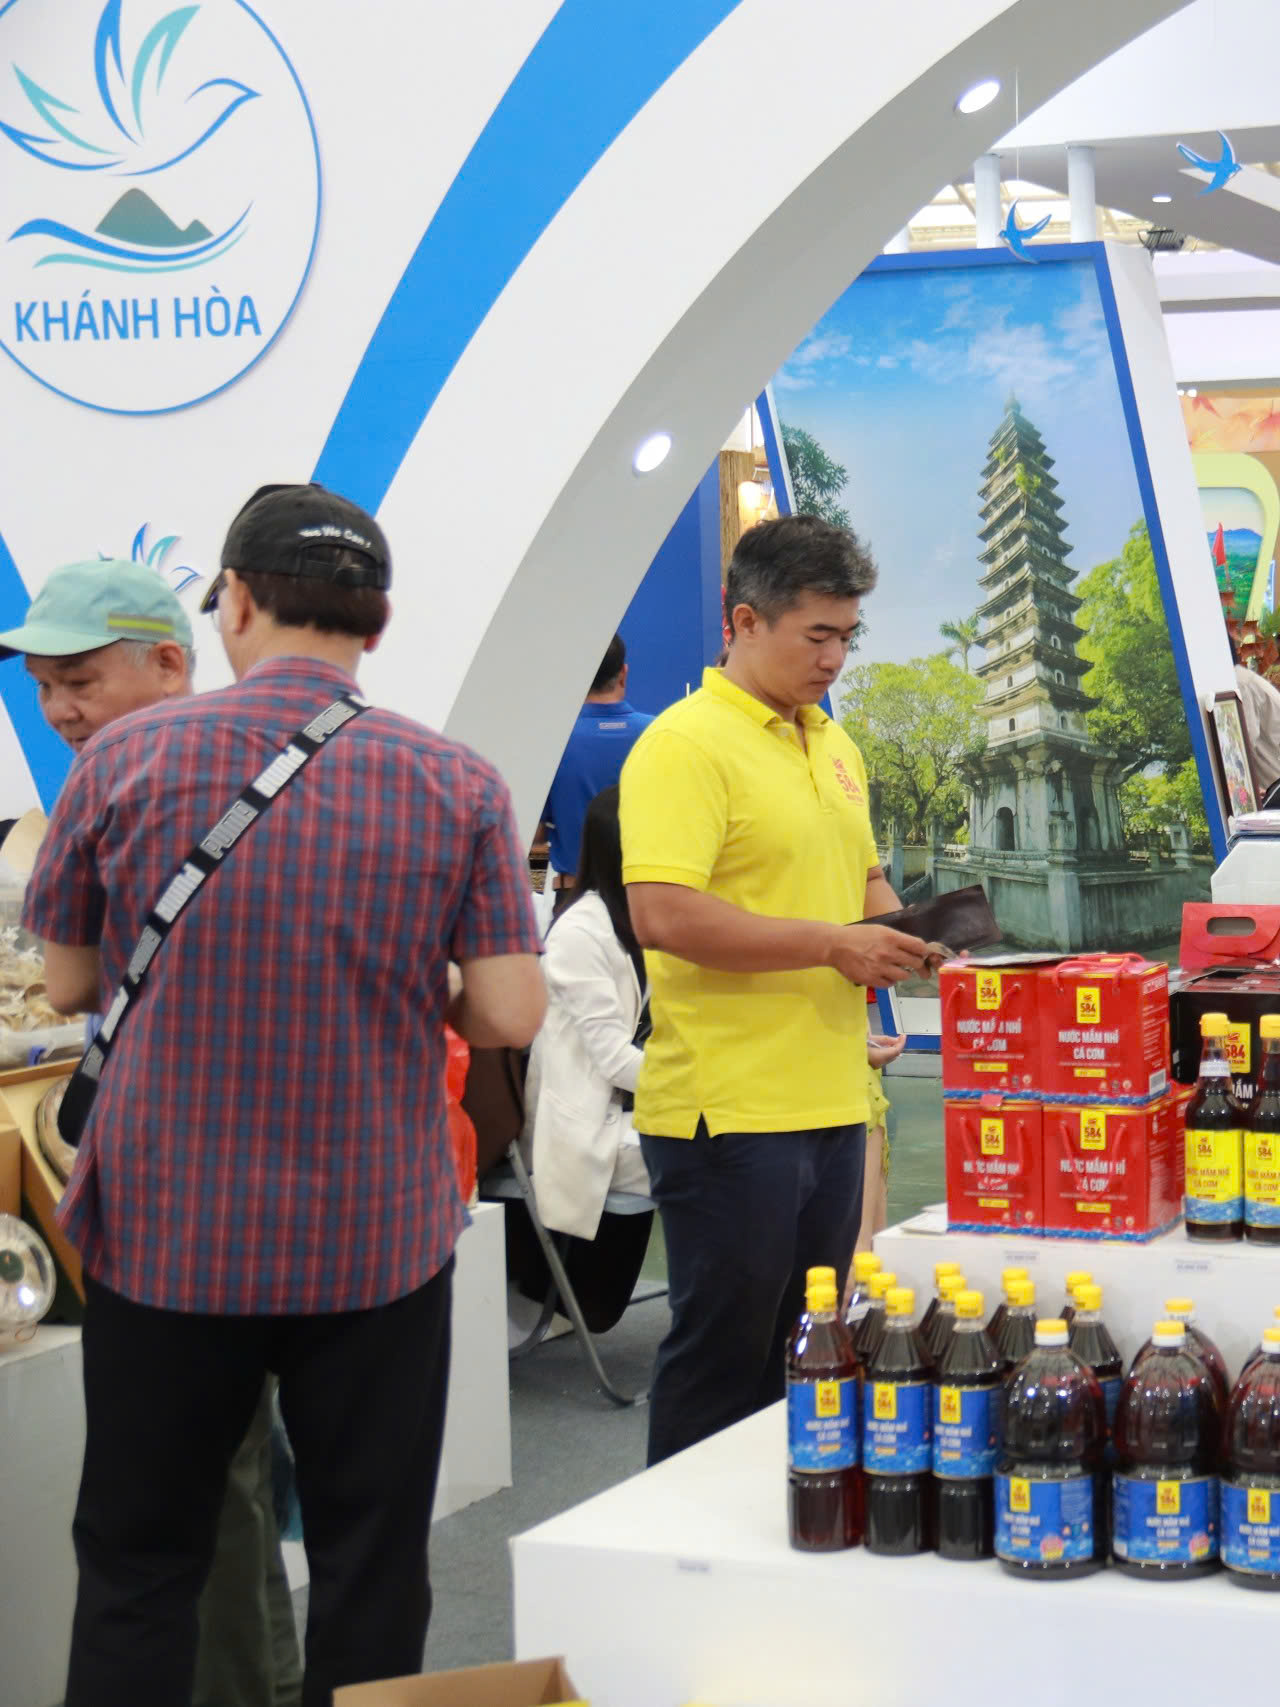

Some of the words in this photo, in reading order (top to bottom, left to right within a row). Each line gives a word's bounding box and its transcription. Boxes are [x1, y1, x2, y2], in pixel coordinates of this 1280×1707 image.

[15, 289, 159, 342] KHÁNH
[174, 285, 262, 338] HÒA
[321, 524, 341, 537] We
[344, 529, 365, 545] Can
[980, 988, 998, 999] 584
[1080, 1002, 1096, 1013] 584
[1058, 1029, 1081, 1043] NƯỚC
[1082, 1027, 1103, 1043] MẮM
[1074, 1046, 1085, 1060] CÁ
[1086, 1047, 1105, 1060] CƠM
[1232, 1078, 1253, 1099] ẮM
[1084, 1128, 1101, 1138] 584
[984, 1134, 1001, 1145] 584
[1197, 1144, 1213, 1154] 584
[1258, 1147, 1273, 1157] 584
